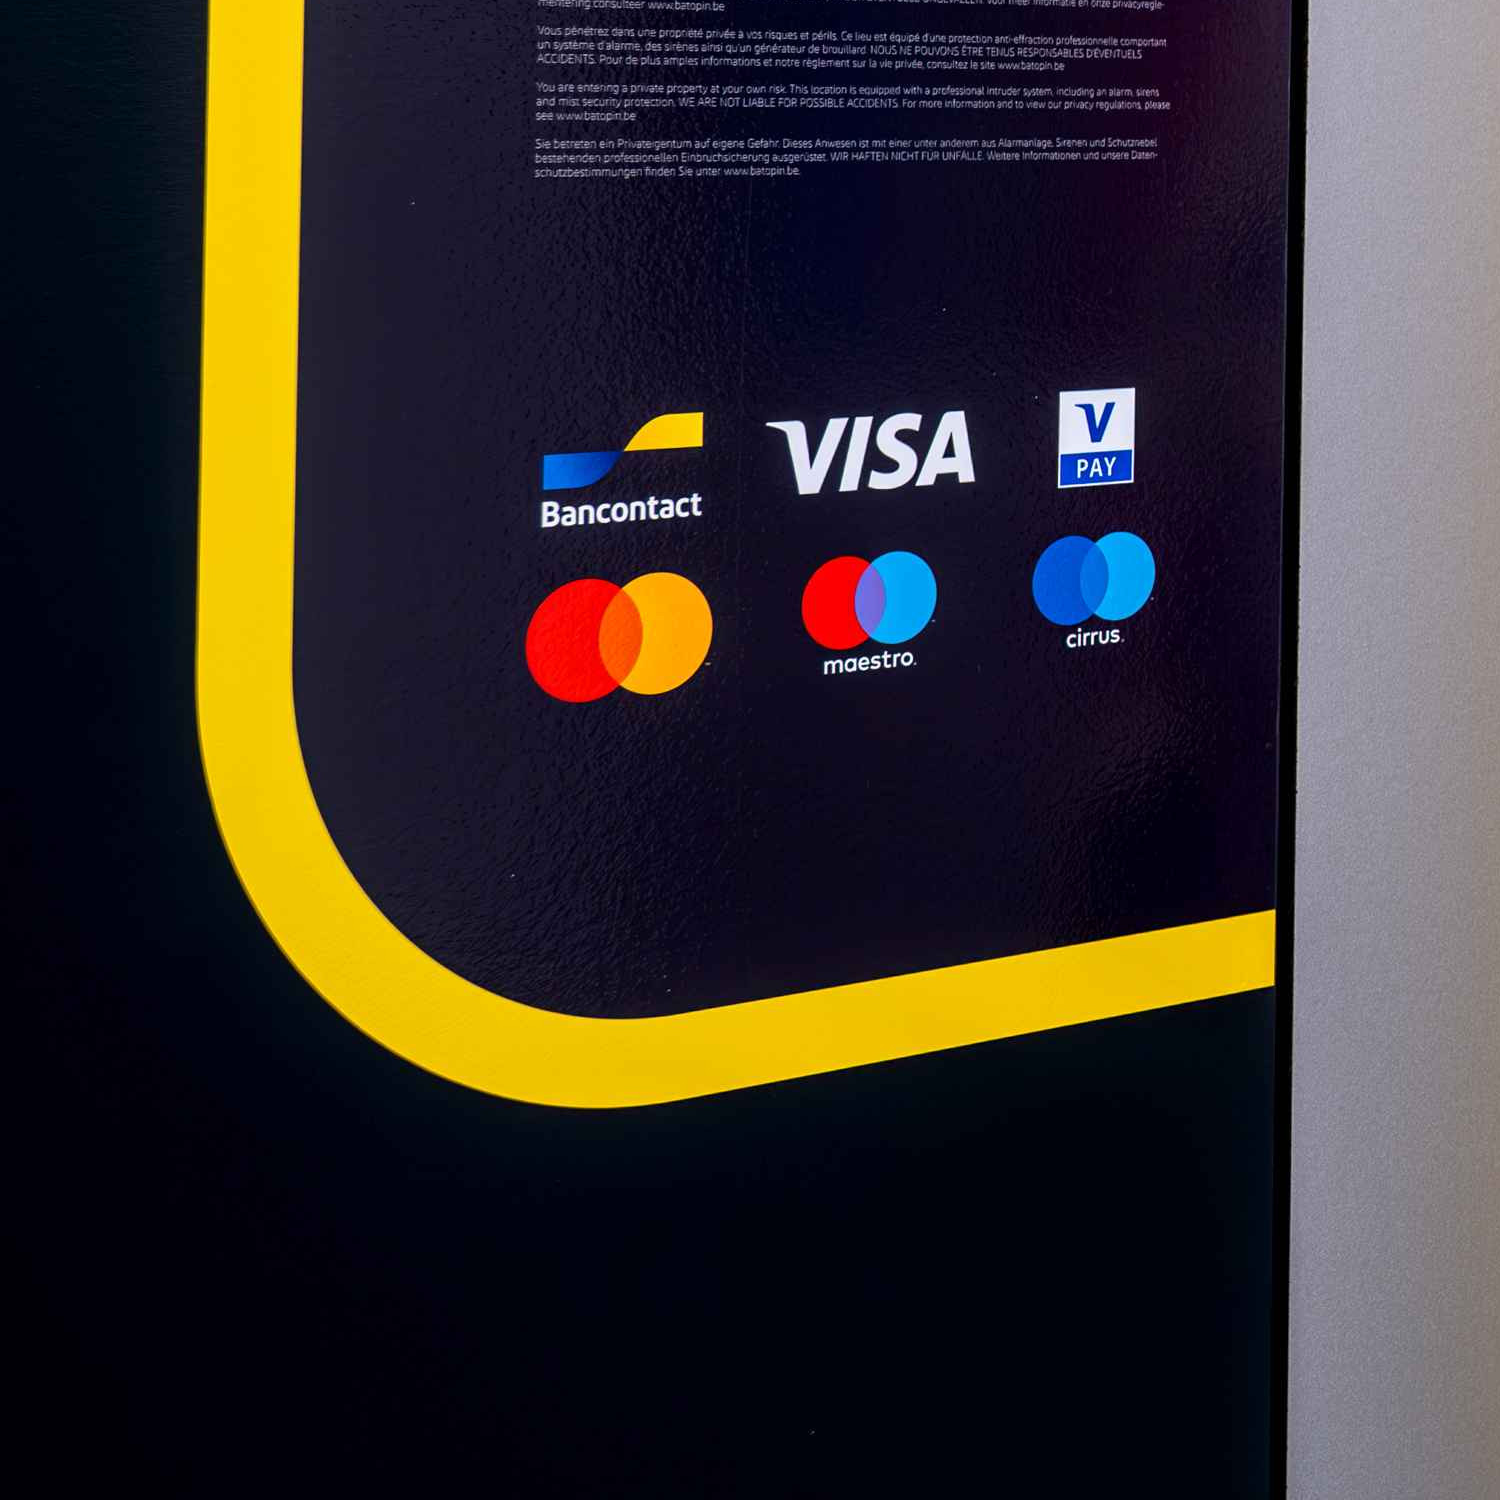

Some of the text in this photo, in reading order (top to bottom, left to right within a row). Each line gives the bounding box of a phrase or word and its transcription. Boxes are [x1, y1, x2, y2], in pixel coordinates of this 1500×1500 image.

[1090, 0, 1110, 7] onze
[537, 25, 561, 36] Vous
[705, 28, 735, 42] privée
[764, 29, 797, 43] risques
[854, 30, 871, 41] lieu
[948, 32, 992, 46] protection
[994, 32, 1053, 44] anti-effraction
[1055, 33, 1118, 48] professionnelle
[1120, 35, 1166, 49] comportant
[701, 41, 722, 53] ainsi
[870, 44, 896, 55] NOUS
[914, 45, 958, 56] POUVONS
[986, 46, 1014, 57] TENUS
[1017, 46, 1084, 58] RESPONSABLES
[599, 54, 622, 65] Pour
[640, 54, 660, 68] plus
[663, 54, 698, 68] amples
[700, 55, 760, 67] informations
[774, 57, 799, 67] notre
[926, 58, 968, 69] consultez
[980, 59, 995, 70] site
[576, 82, 1159, 99] entering private property your own This location equipped with professional intruder including sirens
[697, 96, 716, 107] ARE
[719, 96, 739, 107] NOT
[742, 96, 775, 107] LIABLE
[799, 97, 844, 108] POSSIBLE
[902, 97, 915, 108] For
[918, 100, 942, 108] more
[944, 97, 994, 109] information
[1026, 98, 1045, 109] view
[1063, 98, 1093, 112] privacy
[1144, 98, 1170, 112] please
[712, 137, 744, 151] eigene
[782, 137, 812, 148] Dieses
[814, 137, 856, 148] Anwesen
[888, 137, 910, 148] einer
[913, 138, 936, 148] unter
[940, 137, 978, 148] anderem
[603, 149, 1129, 165] professionellen Einbruchsicherung HAFTEN NICHT Weitere Informationen unsere
[644, 165, 675, 176] finden
[695, 166, 720, 176] unter
[1073, 401, 1116, 443] V
[766, 409, 976, 496] VISA
[1076, 456, 1117, 479] PAY
[540, 493, 703, 529] Bancontact
